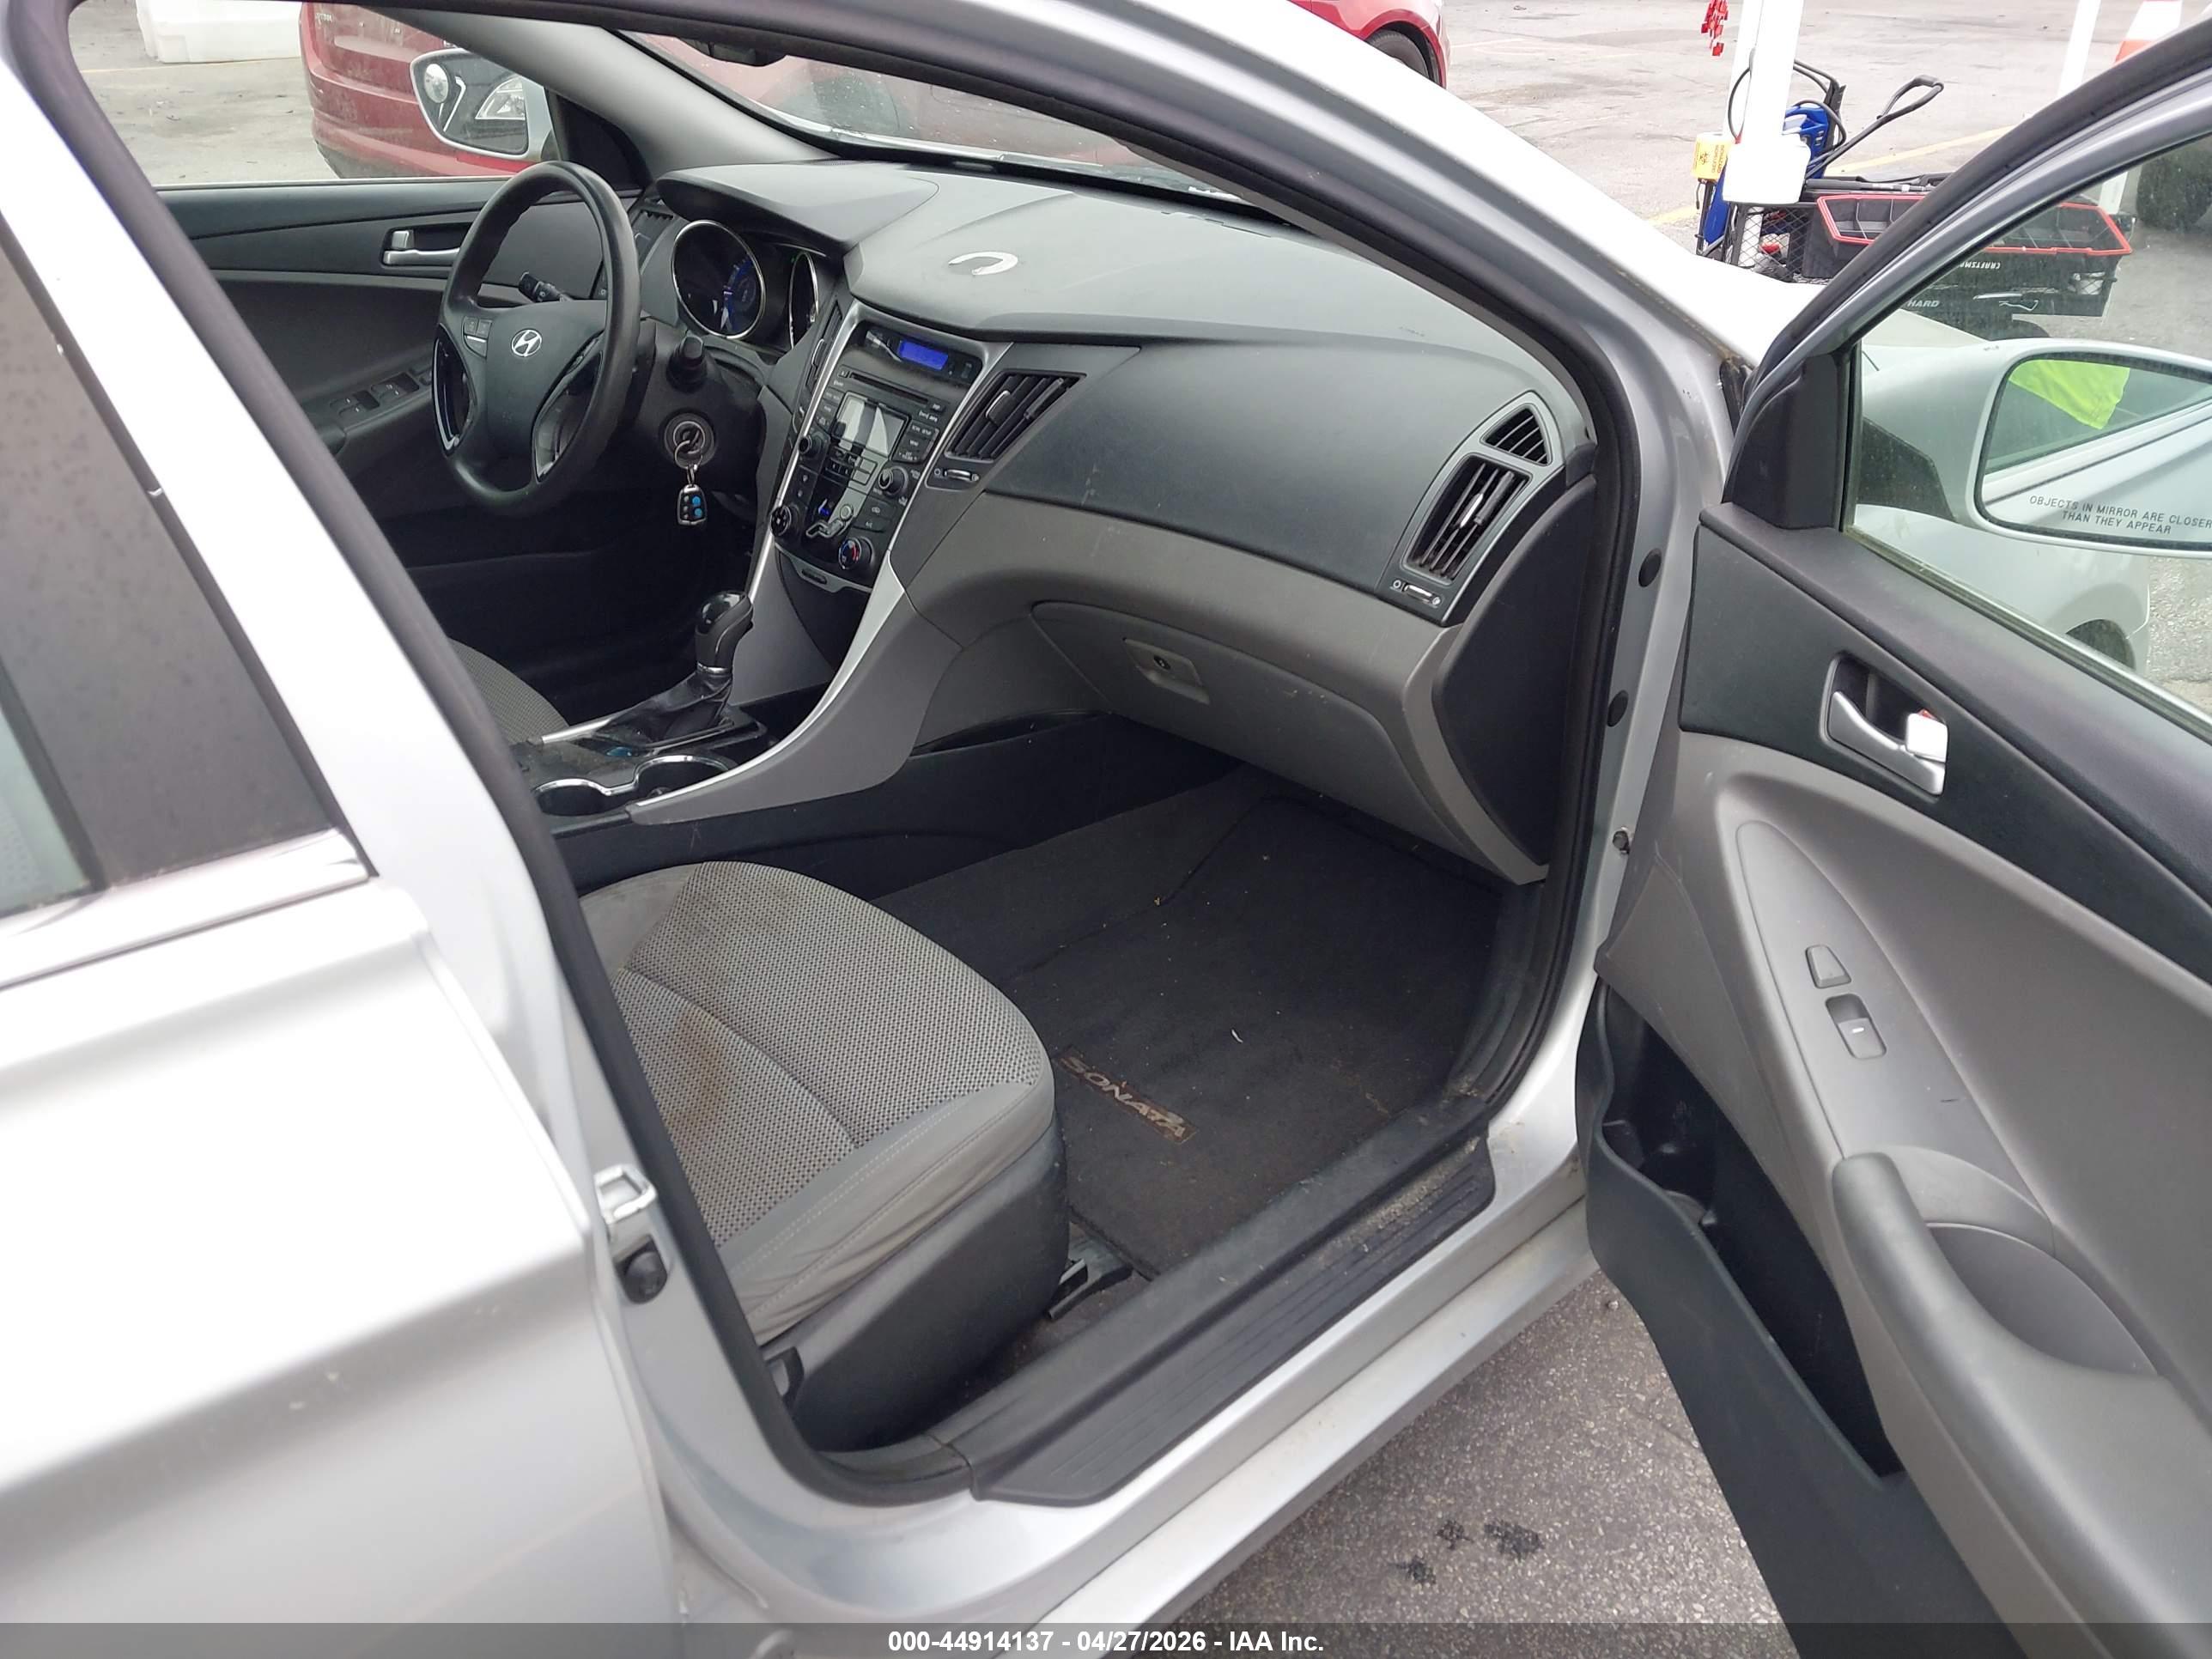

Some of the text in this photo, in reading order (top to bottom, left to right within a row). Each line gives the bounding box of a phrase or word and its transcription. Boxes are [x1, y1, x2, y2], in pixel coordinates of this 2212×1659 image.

[2029, 495, 2212, 529] OBJECTS IN MIRROR ARE CLOSER
[2062, 510, 2172, 534] THAN THEY APPEAR
[1060, 1055, 1187, 1139] SONATA
